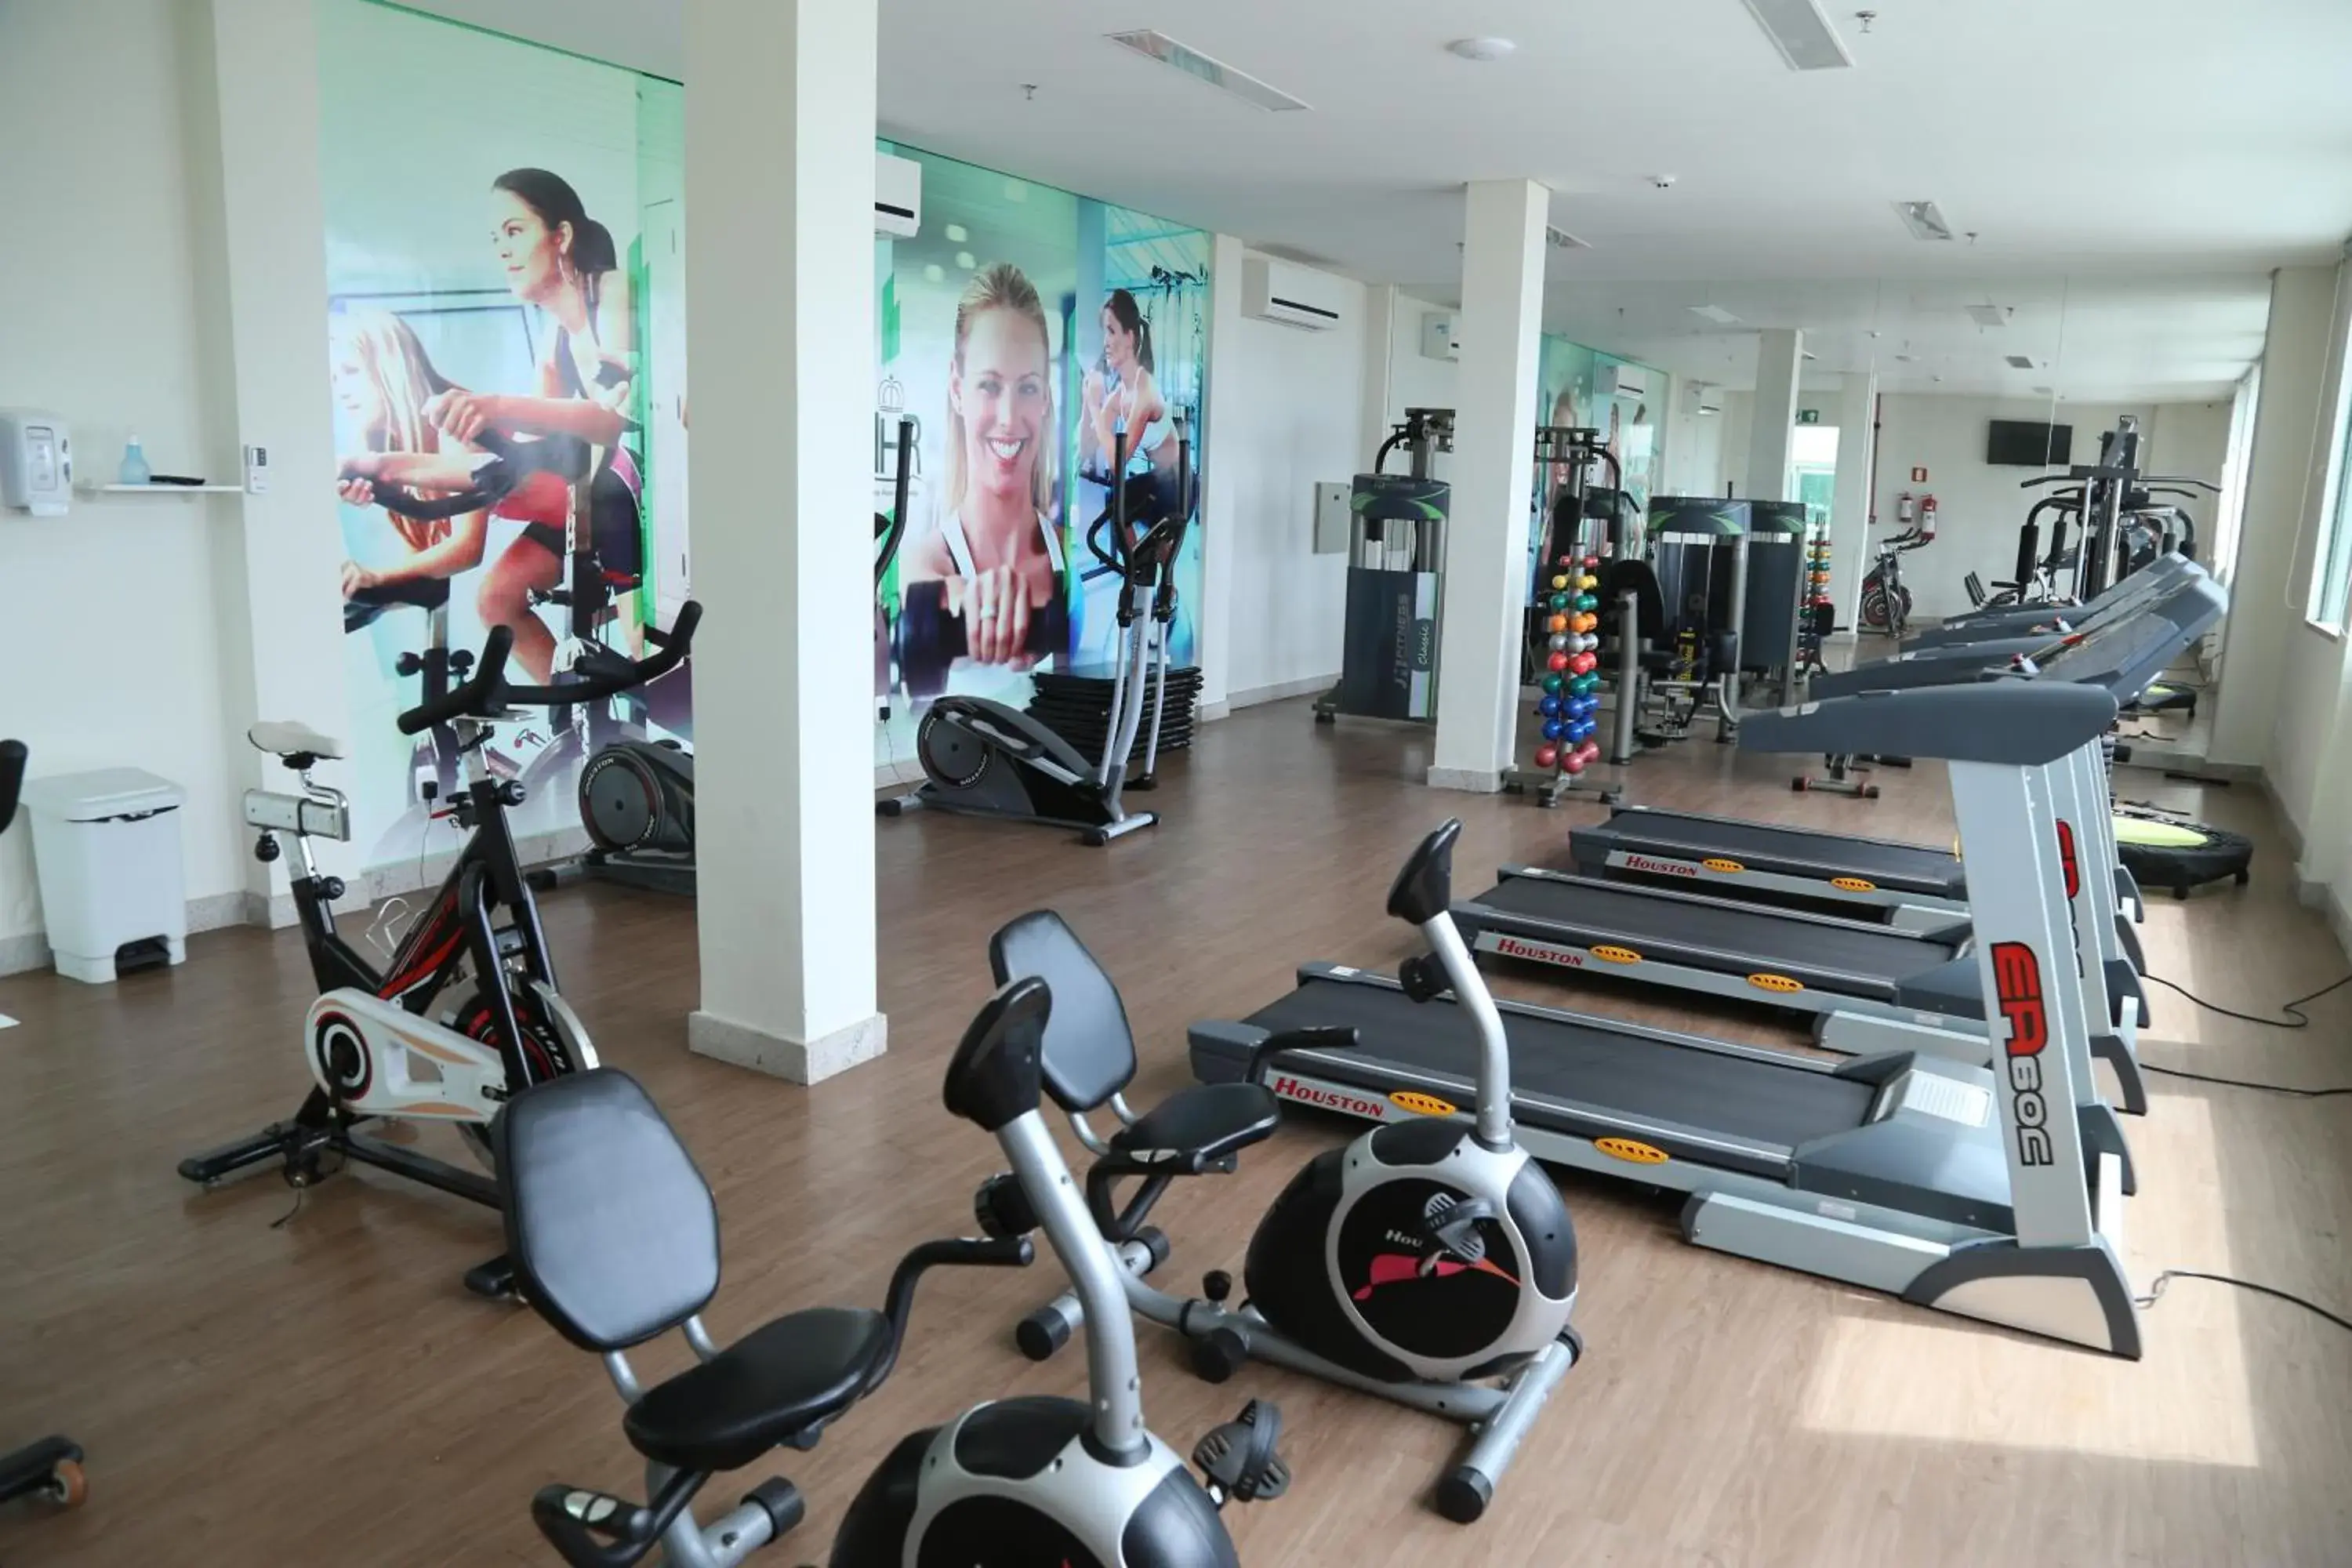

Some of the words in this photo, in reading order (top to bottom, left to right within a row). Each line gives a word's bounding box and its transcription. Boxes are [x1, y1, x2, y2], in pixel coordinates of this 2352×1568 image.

[1417, 624, 1430, 665] Classic
[1625, 855, 1698, 877] HOUSTON
[1497, 938, 1584, 967] HOUSTON
[1275, 1076, 1384, 1117] HOUSTON
